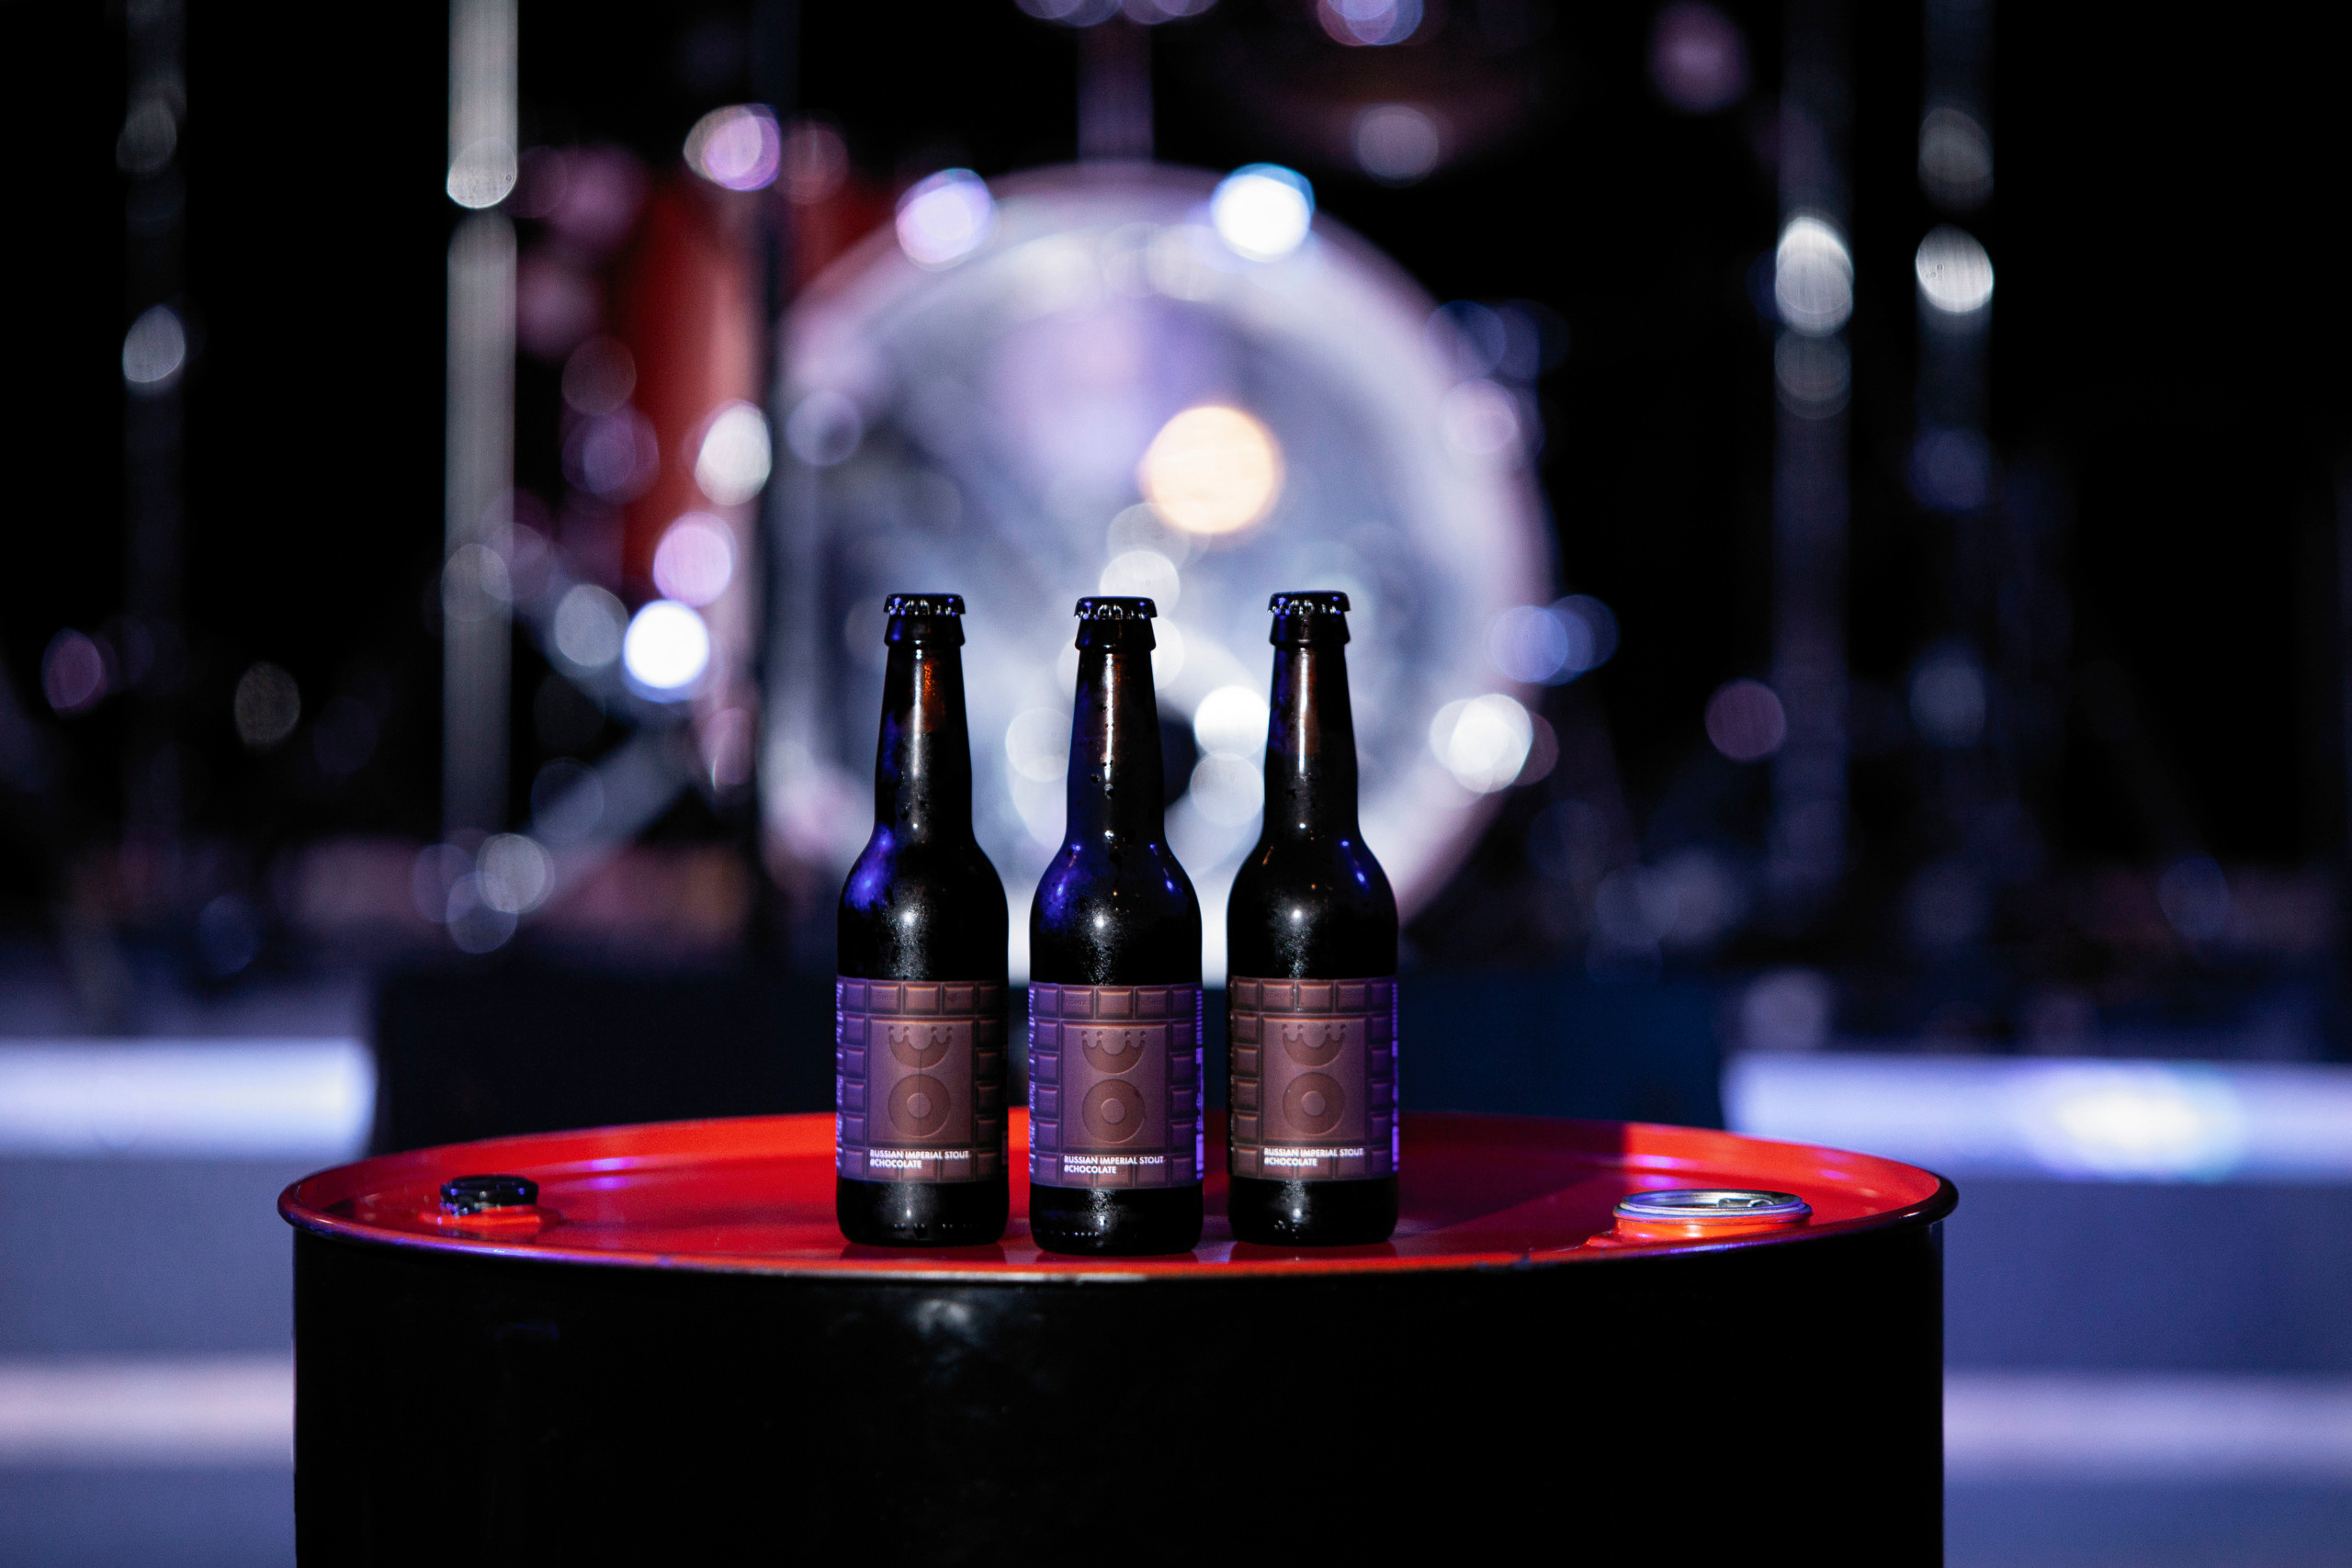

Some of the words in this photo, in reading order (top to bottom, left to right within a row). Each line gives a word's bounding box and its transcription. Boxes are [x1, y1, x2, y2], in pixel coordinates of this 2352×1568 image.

[870, 1149, 904, 1158] RUSSIAN
[905, 1151, 943, 1159] IMPERIAL
[944, 1151, 969, 1159] STOUT
[1264, 1148, 1299, 1157] RUSSIAN
[1300, 1148, 1338, 1157] IMPERIAL
[1340, 1148, 1363, 1157] STOUT
[870, 1158, 922, 1168] #CHOCOLATE
[1064, 1156, 1098, 1164] RUSSIAN
[1100, 1156, 1137, 1165] IMPERIAL
[1139, 1156, 1164, 1165] STOUT
[1264, 1157, 1318, 1167] #CHOCOLATE
[1064, 1165, 1116, 1174] #CHOCOLATE
